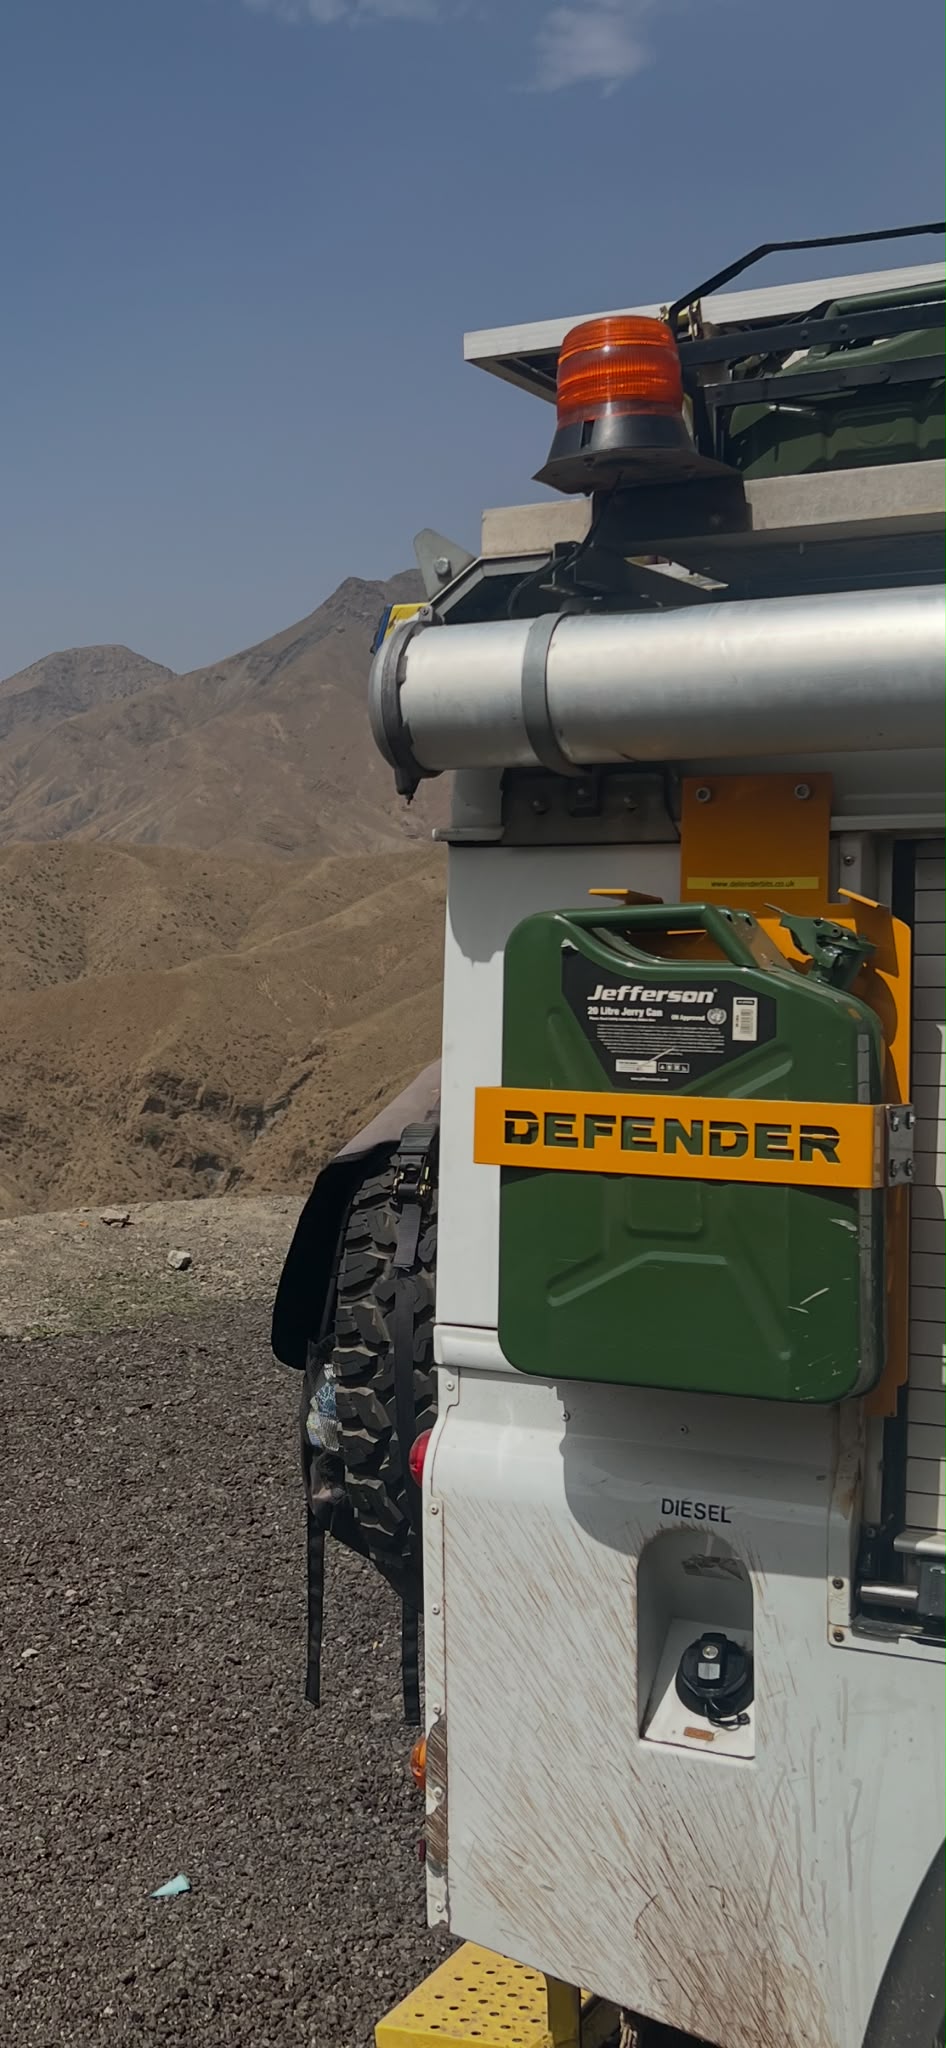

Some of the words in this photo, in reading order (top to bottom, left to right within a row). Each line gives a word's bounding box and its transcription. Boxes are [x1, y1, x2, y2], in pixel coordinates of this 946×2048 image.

[587, 985, 714, 1003] Jefferson
[587, 1006, 599, 1015] 20
[600, 1006, 620, 1016] Litre
[621, 1007, 645, 1018] Jerry
[646, 1008, 663, 1017] Can
[504, 1109, 841, 1163] DEFENDER
[661, 1498, 732, 1523] DIESEL
